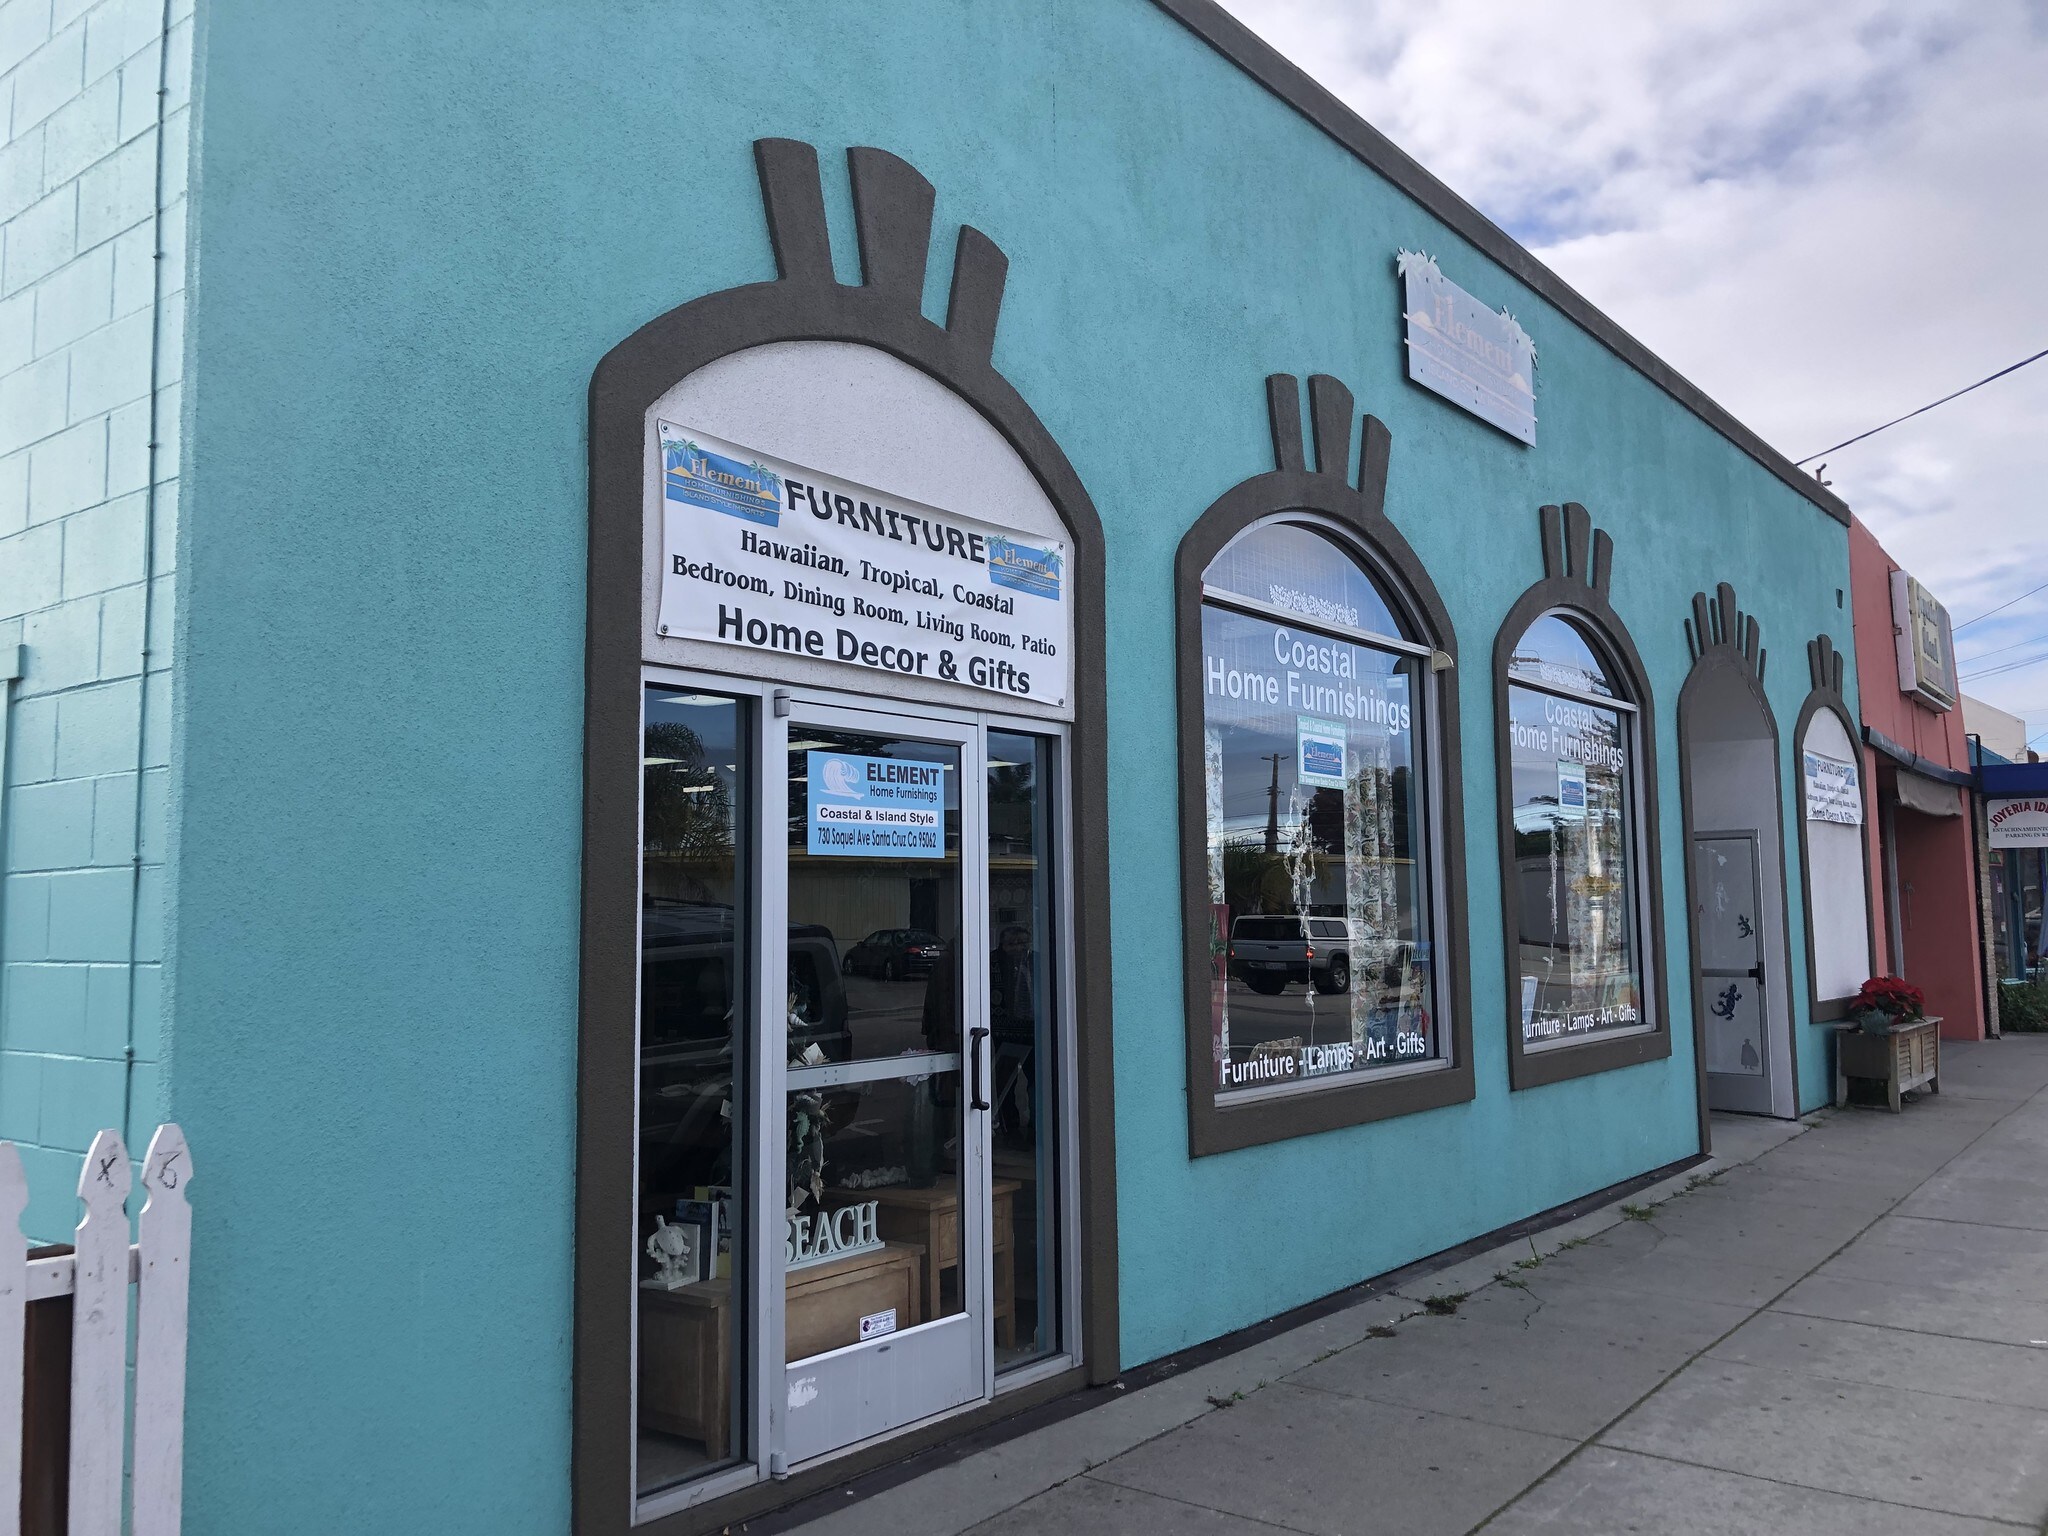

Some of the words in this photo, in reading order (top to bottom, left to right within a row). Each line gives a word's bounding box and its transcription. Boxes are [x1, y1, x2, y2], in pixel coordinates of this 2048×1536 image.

[684, 478, 708, 492] HOME
[710, 486, 766, 506] FURNISHINGS
[690, 457, 762, 493] Element
[682, 489, 710, 502] ISLAND
[784, 479, 986, 564] FURNITURE
[741, 529, 850, 578] Hawaiian,
[860, 560, 944, 600] Tropical,
[952, 583, 1014, 616] Coastal
[1004, 548, 1049, 573] Element
[672, 554, 775, 597] Bedroom,
[783, 579, 846, 617] Dining
[853, 595, 909, 626] Room,
[916, 610, 965, 642] Living
[970, 622, 1016, 650] Room,
[1021, 634, 1056, 657] Patio
[718, 604, 824, 657] Home
[836, 628, 929, 675] Decor
[938, 649, 960, 682] &
[968, 655, 1030, 694] Gifts
[1274, 628, 1357, 680] Coastal
[1207, 655, 1279, 704] Home
[1287, 670, 1411, 736] Furnishings
[1545, 696, 1593, 731] Coastal
[1551, 726, 1624, 773] Furnishings
[867, 762, 940, 786] ELEMENT
[870, 784, 894, 798] Home
[896, 786, 938, 803] Furnishings
[820, 807, 861, 820] Coastal
[864, 810, 873, 820] &
[875, 810, 907, 823] Island
[909, 812, 934, 825] Style
[1989, 801, 2032, 828] JOYERIA
[817, 827, 831, 845] 730
[832, 828, 856, 849] Soquel
[857, 831, 871, 846] Ave
[872, 831, 891, 847] Santa
[891, 832, 907, 847] Cruz
[908, 832, 917, 848] Ca
[919, 832, 937, 849] 95062
[1522, 1017, 1560, 1039] urniture
[1567, 1012, 1595, 1032] Lamps
[1601, 1007, 1613, 1025] Art
[1618, 1002, 1636, 1022] Gifts
[1221, 1053, 1294, 1085] Furniture
[1308, 1044, 1354, 1071] Lamps
[1366, 1036, 1387, 1060] Art
[1397, 1032, 1425, 1054] Gifts
